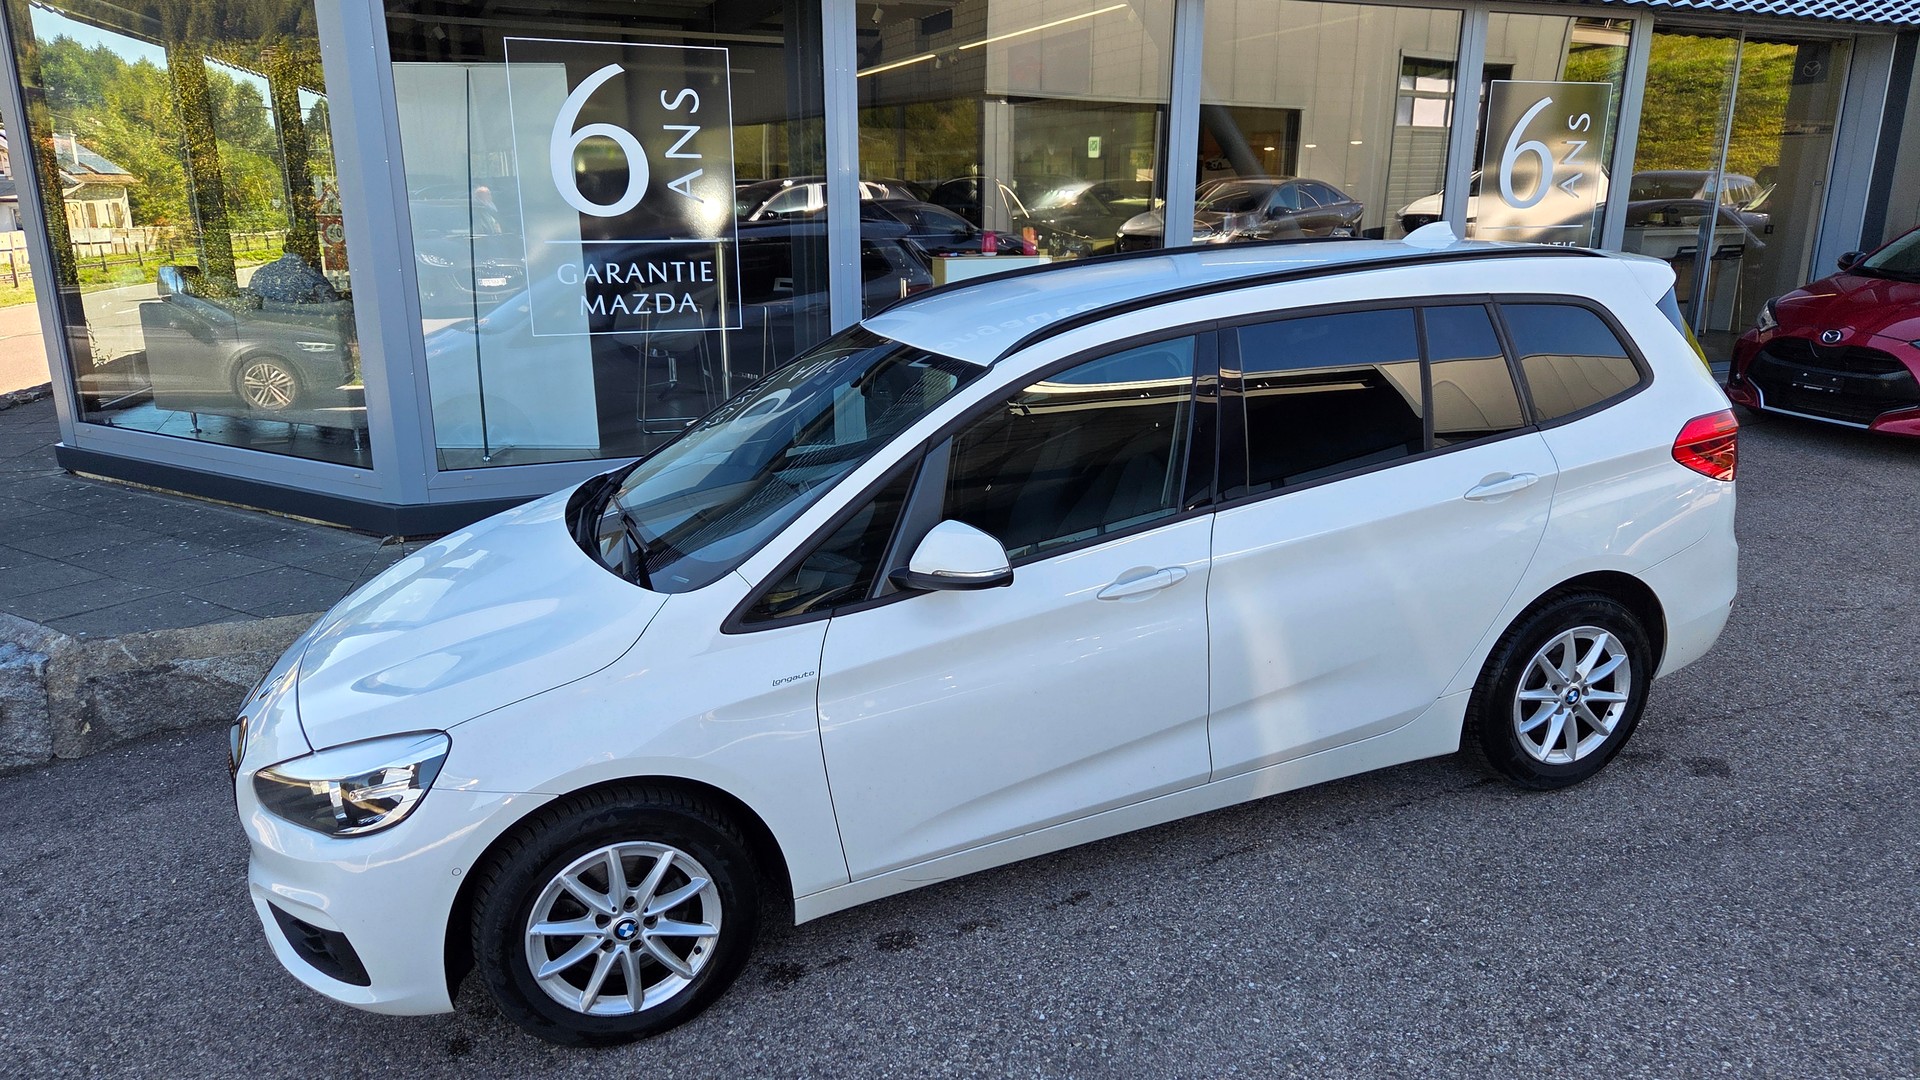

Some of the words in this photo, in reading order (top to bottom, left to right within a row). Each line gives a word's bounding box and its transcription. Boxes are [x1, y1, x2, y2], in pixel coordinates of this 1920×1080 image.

[550, 63, 650, 218] 6
[660, 87, 705, 204] ANS
[1499, 96, 1554, 210] 6
[1559, 112, 1592, 199] ANS
[556, 260, 714, 285] GARANTIE
[580, 293, 698, 316] MAZDA
